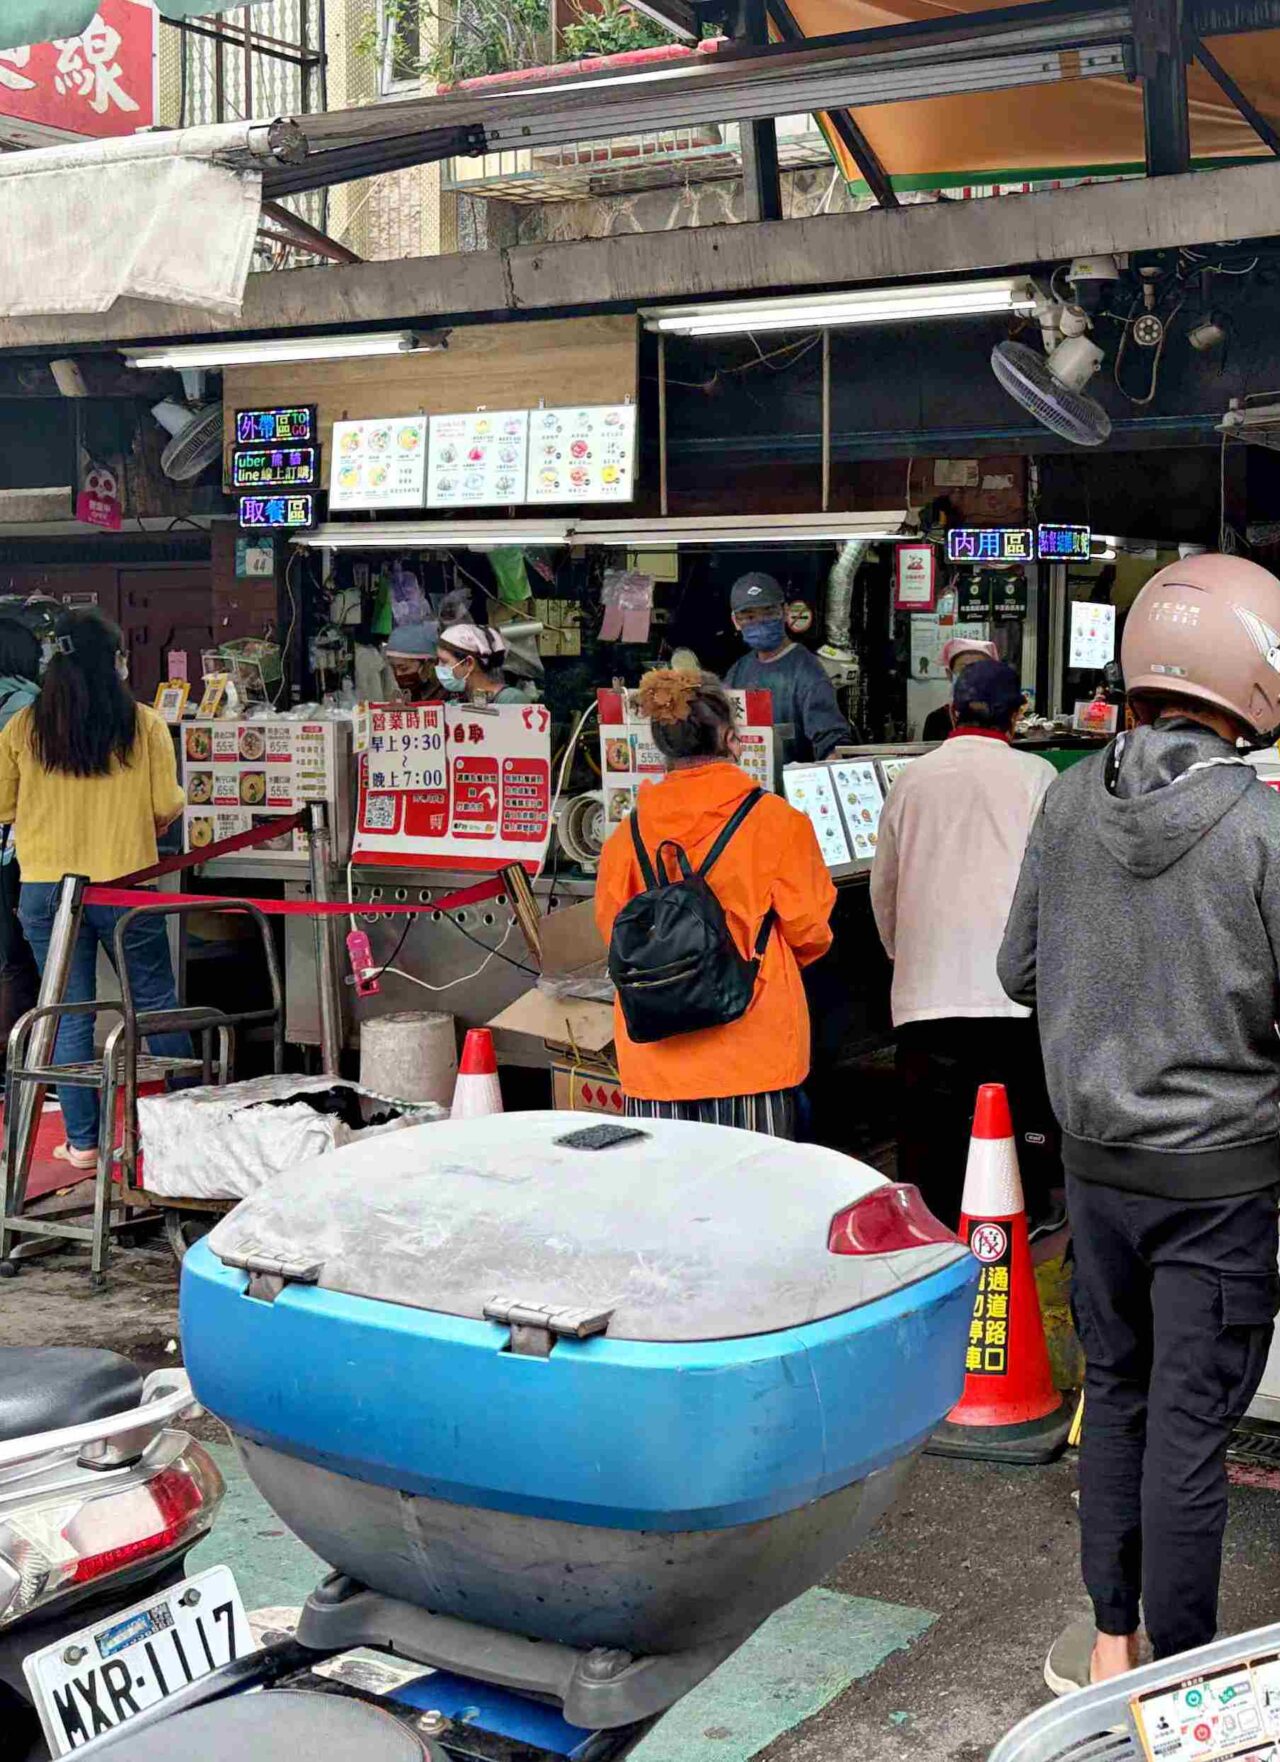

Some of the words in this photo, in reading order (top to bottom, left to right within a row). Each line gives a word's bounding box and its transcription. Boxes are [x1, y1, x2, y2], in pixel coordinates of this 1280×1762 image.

[241, 414, 291, 439] 外帶區
[291, 424, 306, 436] GO
[292, 414, 306, 424] TO
[239, 455, 265, 467] uber
[239, 468, 259, 481] line
[244, 500, 307, 522] 取餐區
[954, 532, 1027, 557] 內用區
[373, 711, 438, 736] 營業時間
[444, 722, 484, 745] 自取
[984, 1265, 1009, 1372] 通道路口
